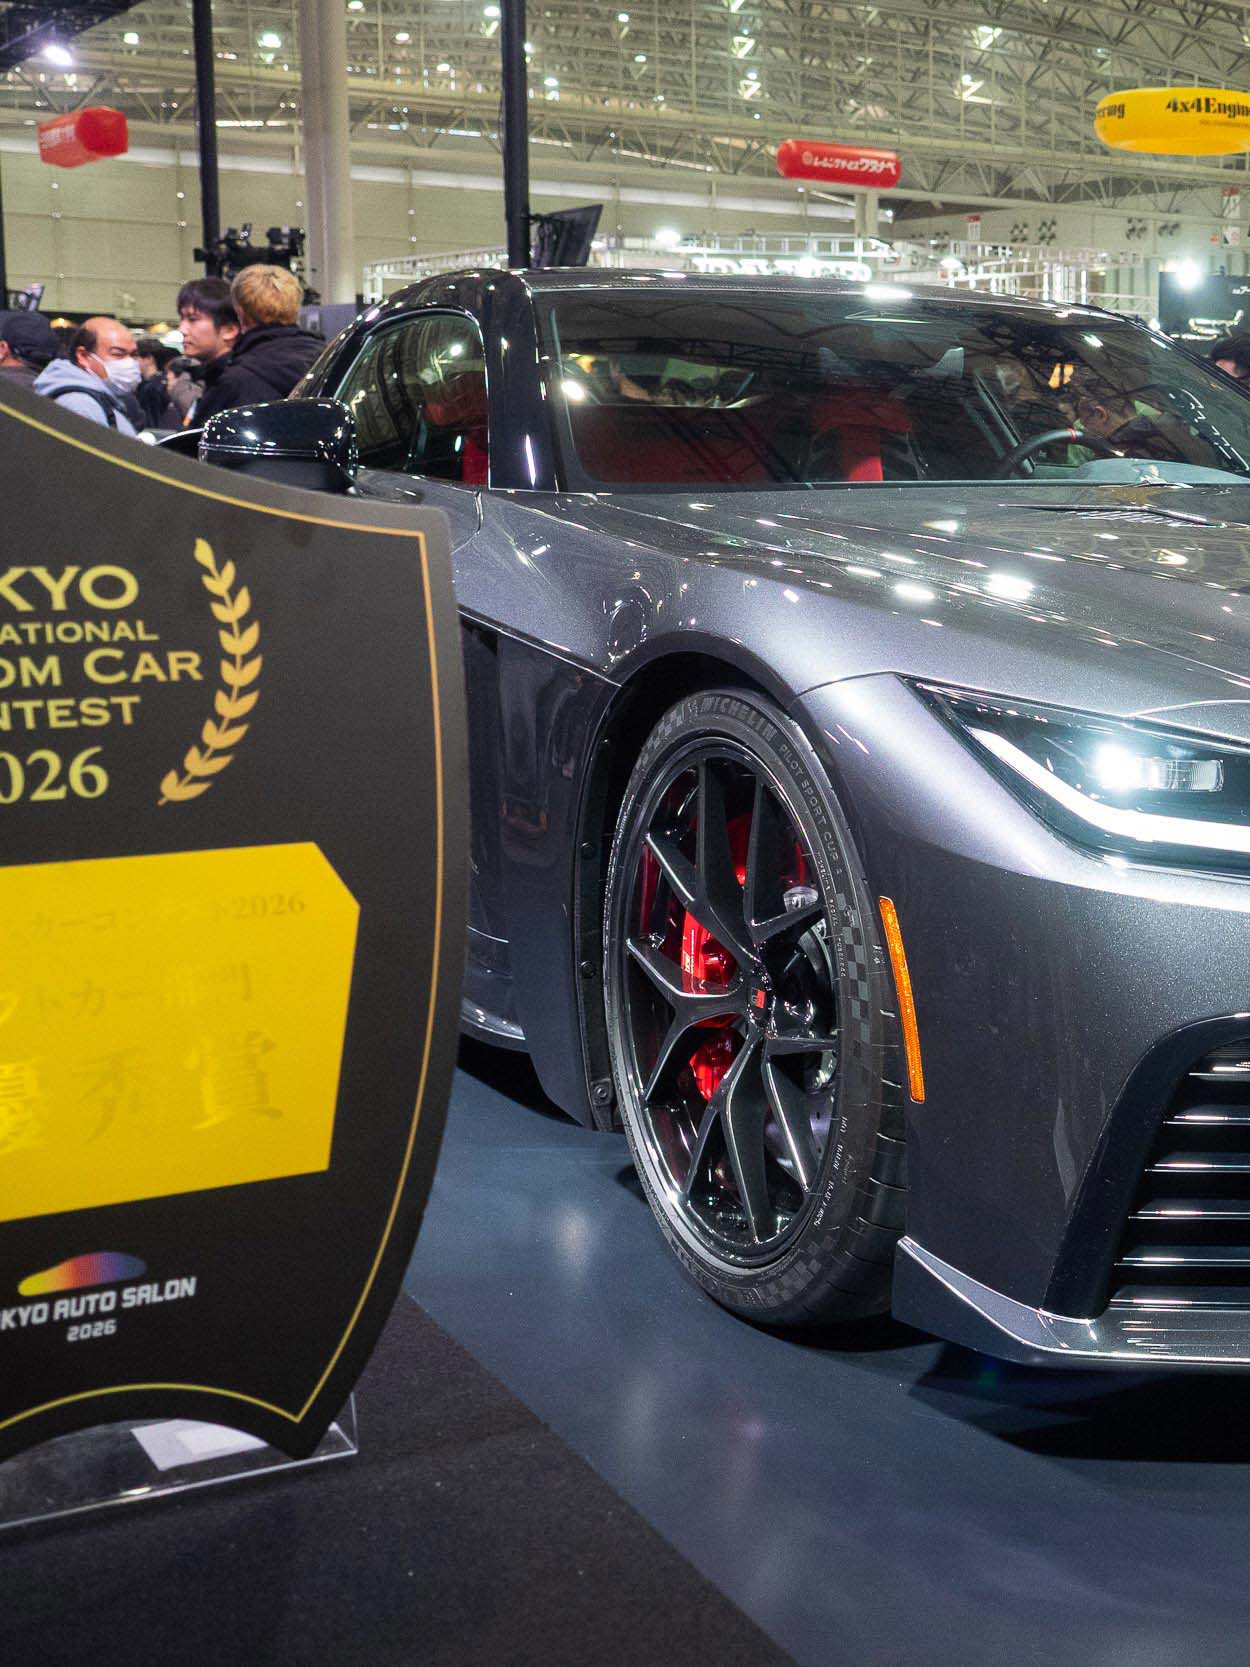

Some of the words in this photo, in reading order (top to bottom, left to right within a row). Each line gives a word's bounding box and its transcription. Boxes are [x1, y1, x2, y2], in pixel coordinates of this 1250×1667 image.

[699, 697, 778, 742] MICHELIN
[779, 743, 804, 777] PILOT
[801, 780, 827, 825] SPORT
[823, 831, 839, 860] CUP
[53, 1291, 117, 1321] AUTO
[121, 1276, 197, 1309] SALON
[66, 1319, 117, 1342] 2026
